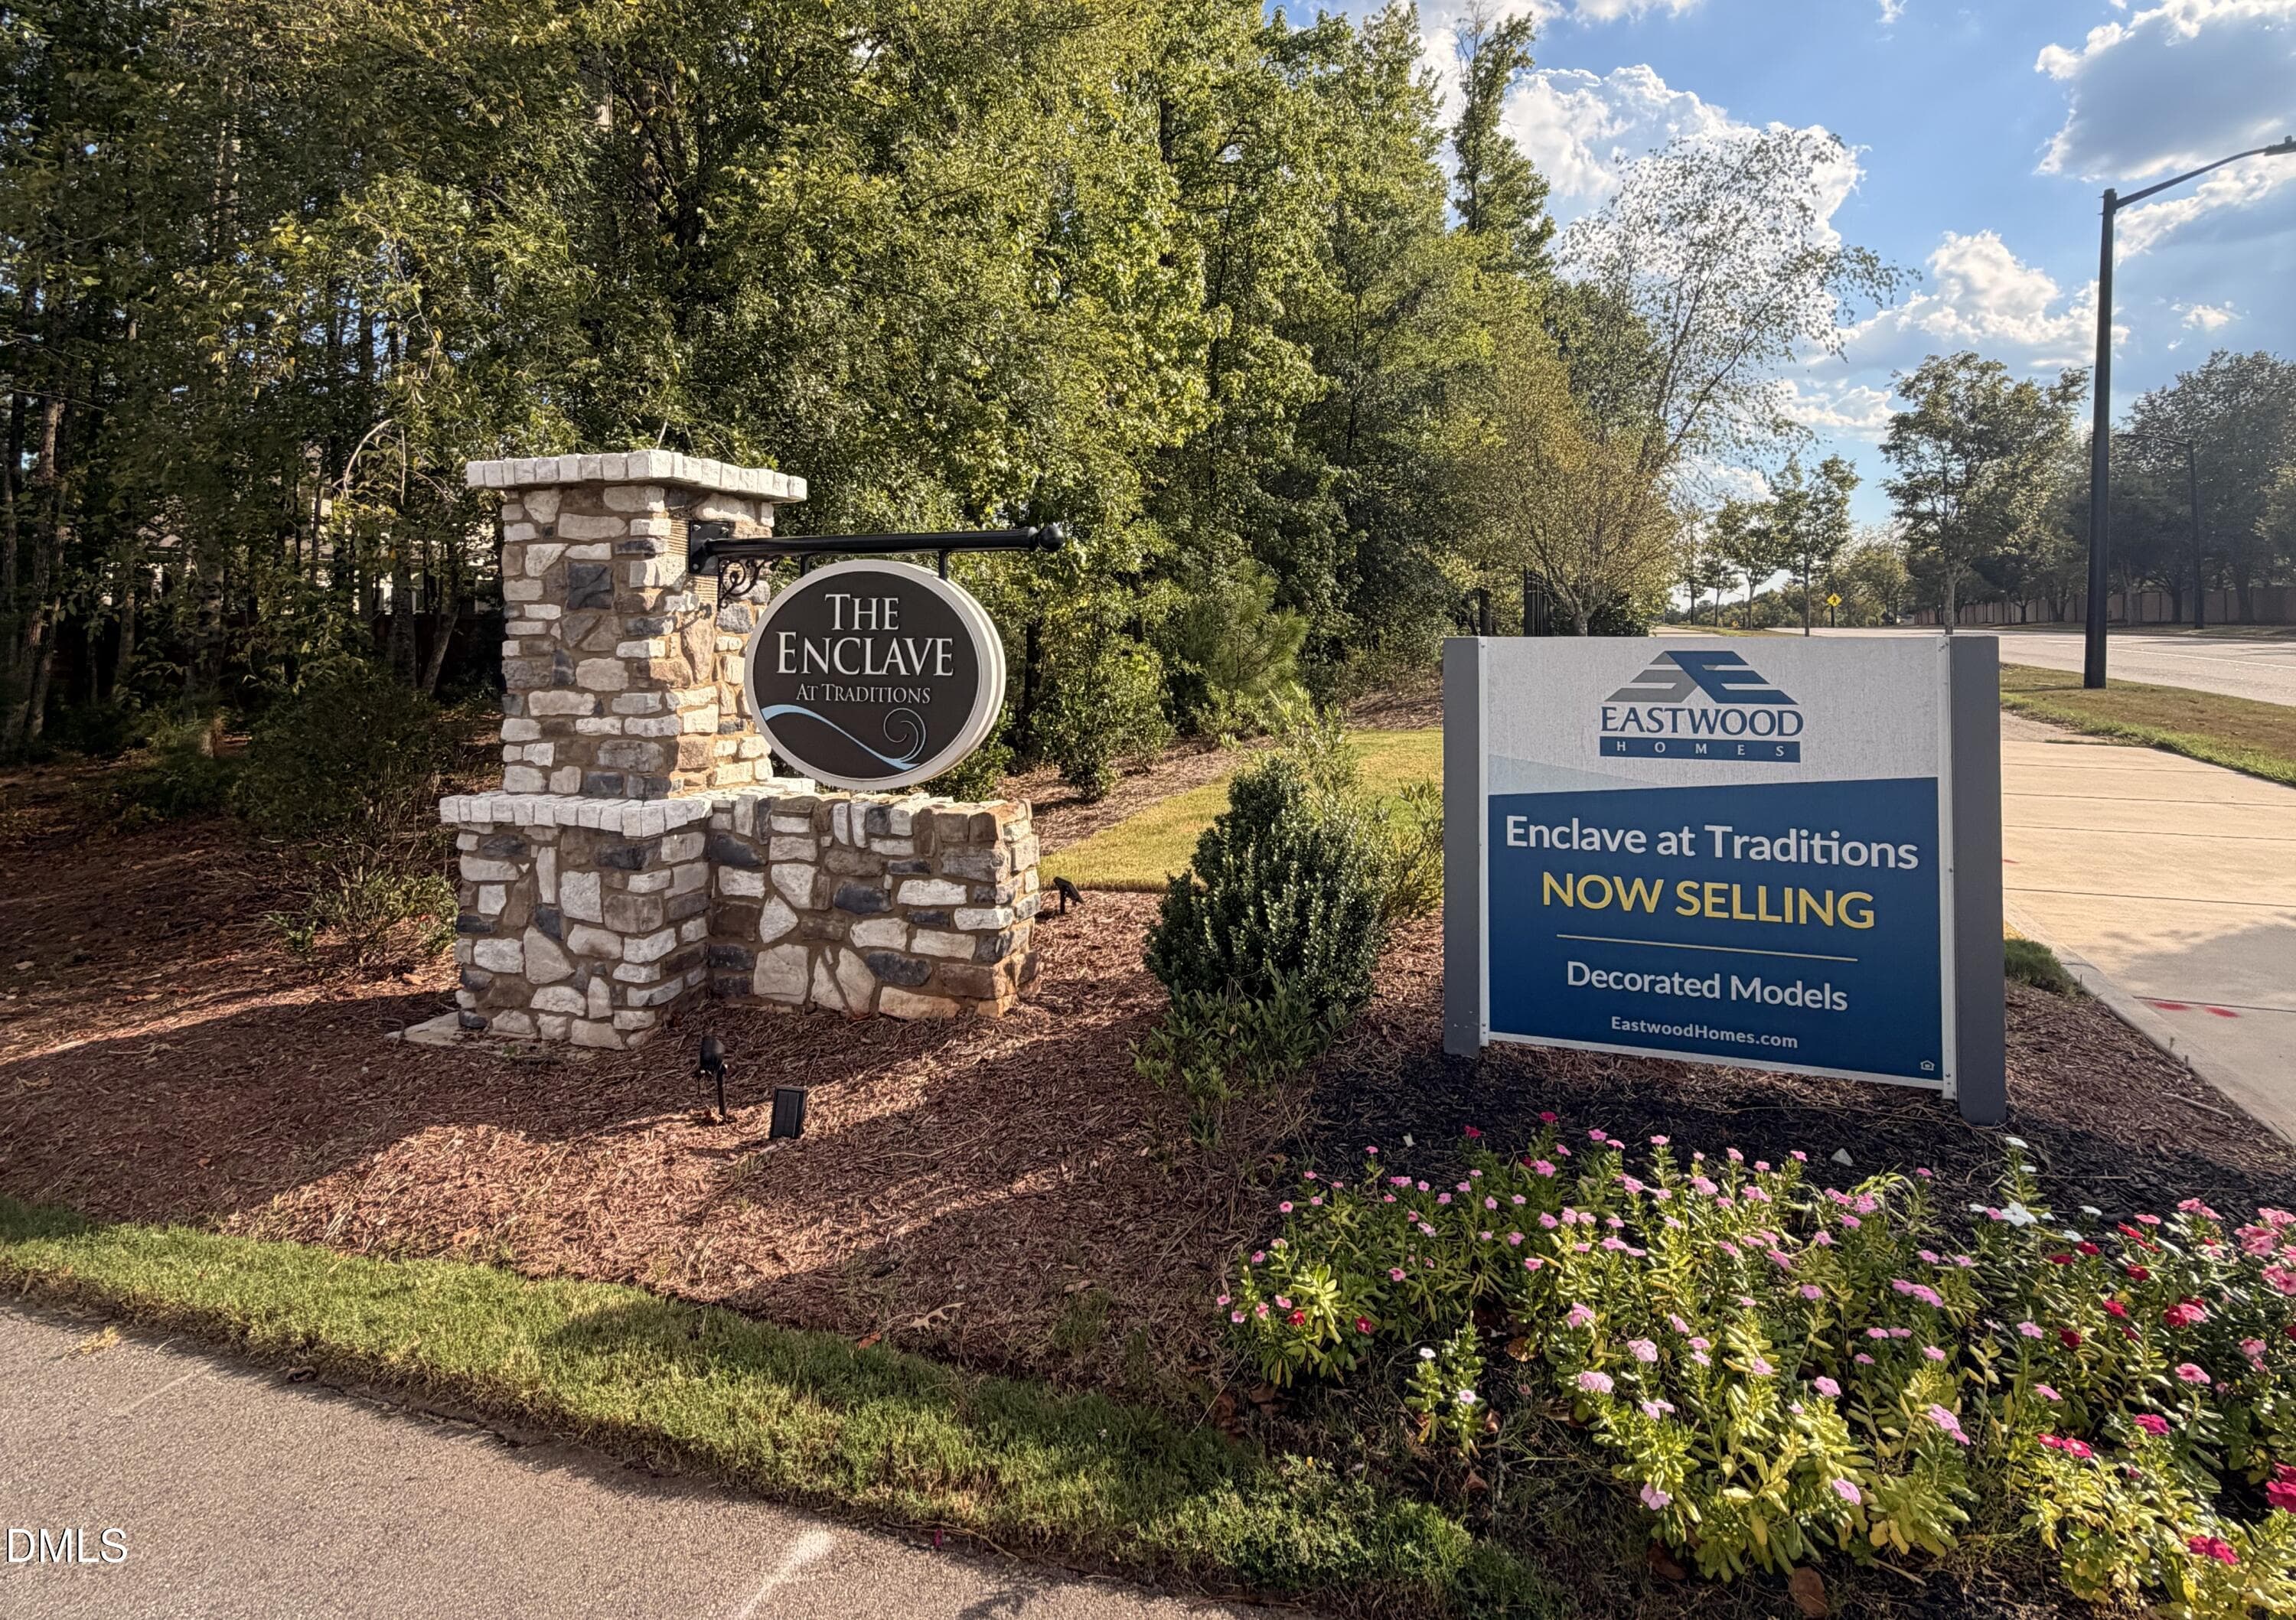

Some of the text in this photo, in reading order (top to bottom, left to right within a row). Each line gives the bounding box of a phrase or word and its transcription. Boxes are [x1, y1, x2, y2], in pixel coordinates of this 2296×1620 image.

[825, 593, 899, 631] THE
[776, 631, 954, 676] ENCLAVE
[796, 683, 931, 704] AT TRADITIONS
[1601, 706, 1804, 736] EASTWOOD
[1616, 741, 1785, 757] HOMES
[1506, 815, 1919, 869] Enclave at Traditions
[1543, 872, 1875, 929] NOW SELLING
[1567, 961, 1848, 1012] Decorated Models
[1611, 1016, 1799, 1048] EastwoodHomes.com
